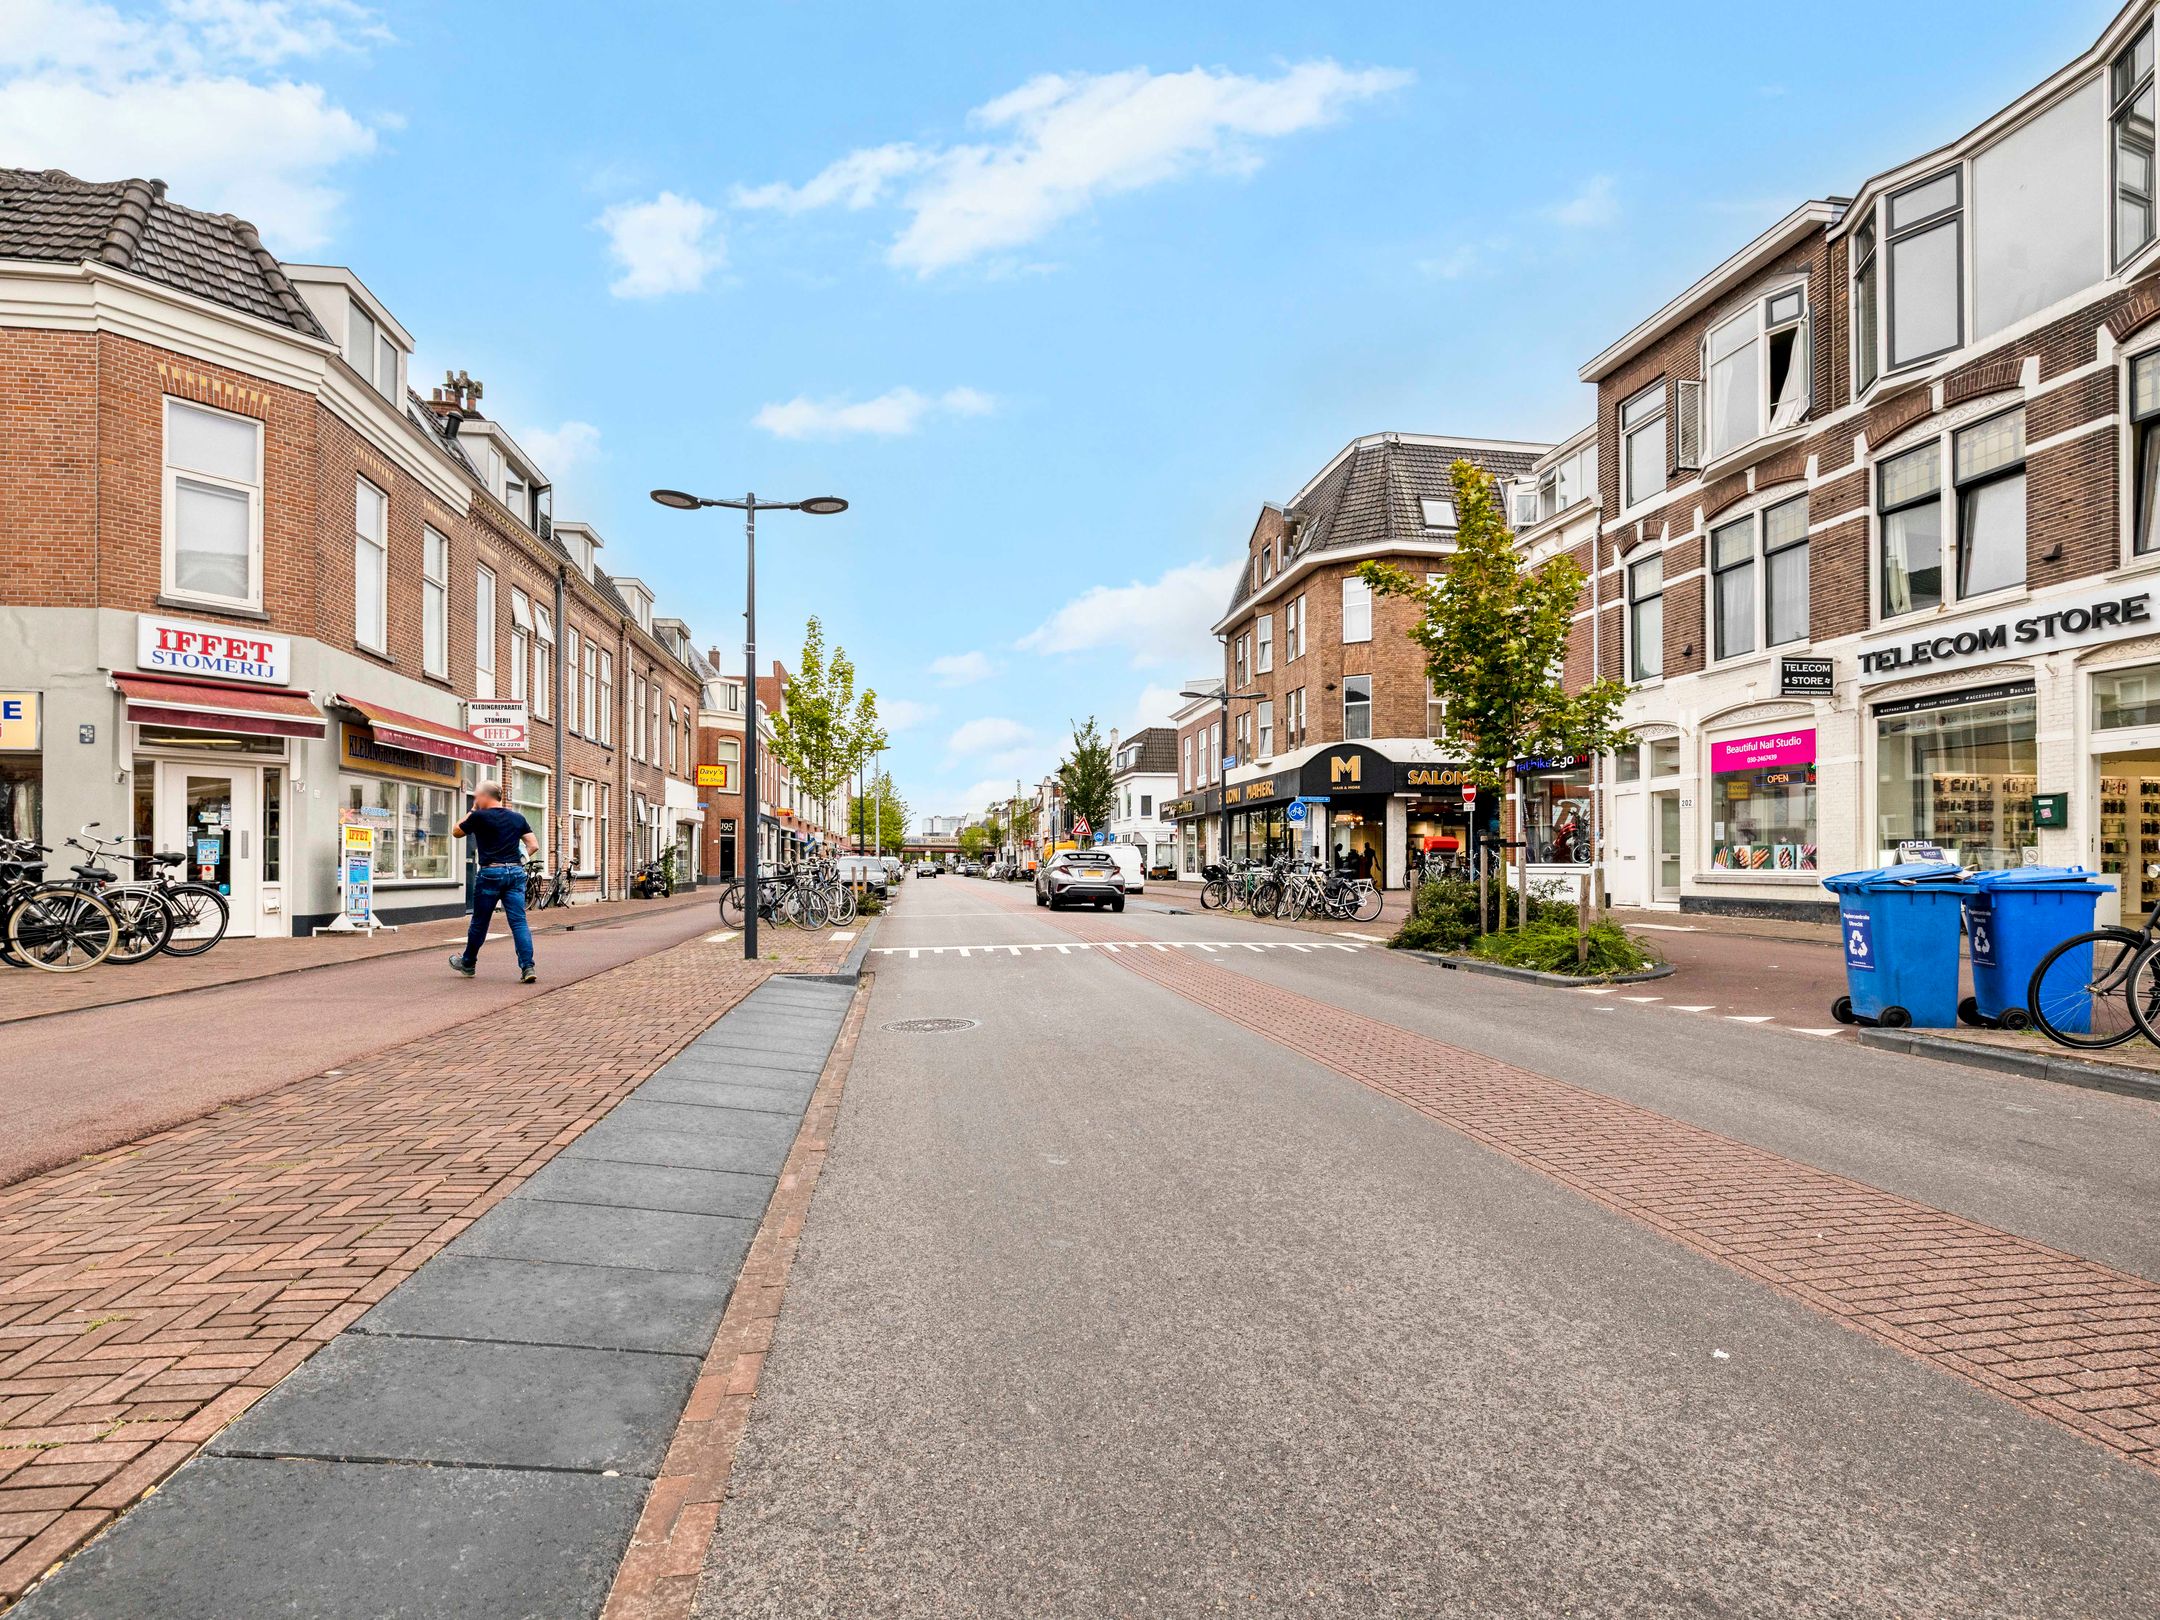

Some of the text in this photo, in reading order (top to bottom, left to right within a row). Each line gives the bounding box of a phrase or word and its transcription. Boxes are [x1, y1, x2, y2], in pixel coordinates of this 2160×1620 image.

[1858, 592, 2151, 674] TELECOM STORE
[156, 627, 273, 664] IFFET
[152, 650, 276, 678] STOMERIJ
[1784, 663, 1831, 673] TELECOM
[1791, 676, 1824, 685] STORE
[471, 703, 522, 711] KLEDINGREPARATIE
[1989, 706, 2018, 718] SONY
[484, 728, 510, 739] IFFET
[1726, 736, 1802, 755] Beautiful Nail Studio
[700, 768, 724, 776] Davy's
[1331, 755, 1361, 783] M
[1408, 769, 1469, 786] SALON
[1767, 773, 1789, 784] OPEN
[1681, 799, 1692, 807] 202
[721, 822, 734, 832] 195
[349, 829, 368, 841] IFFET
